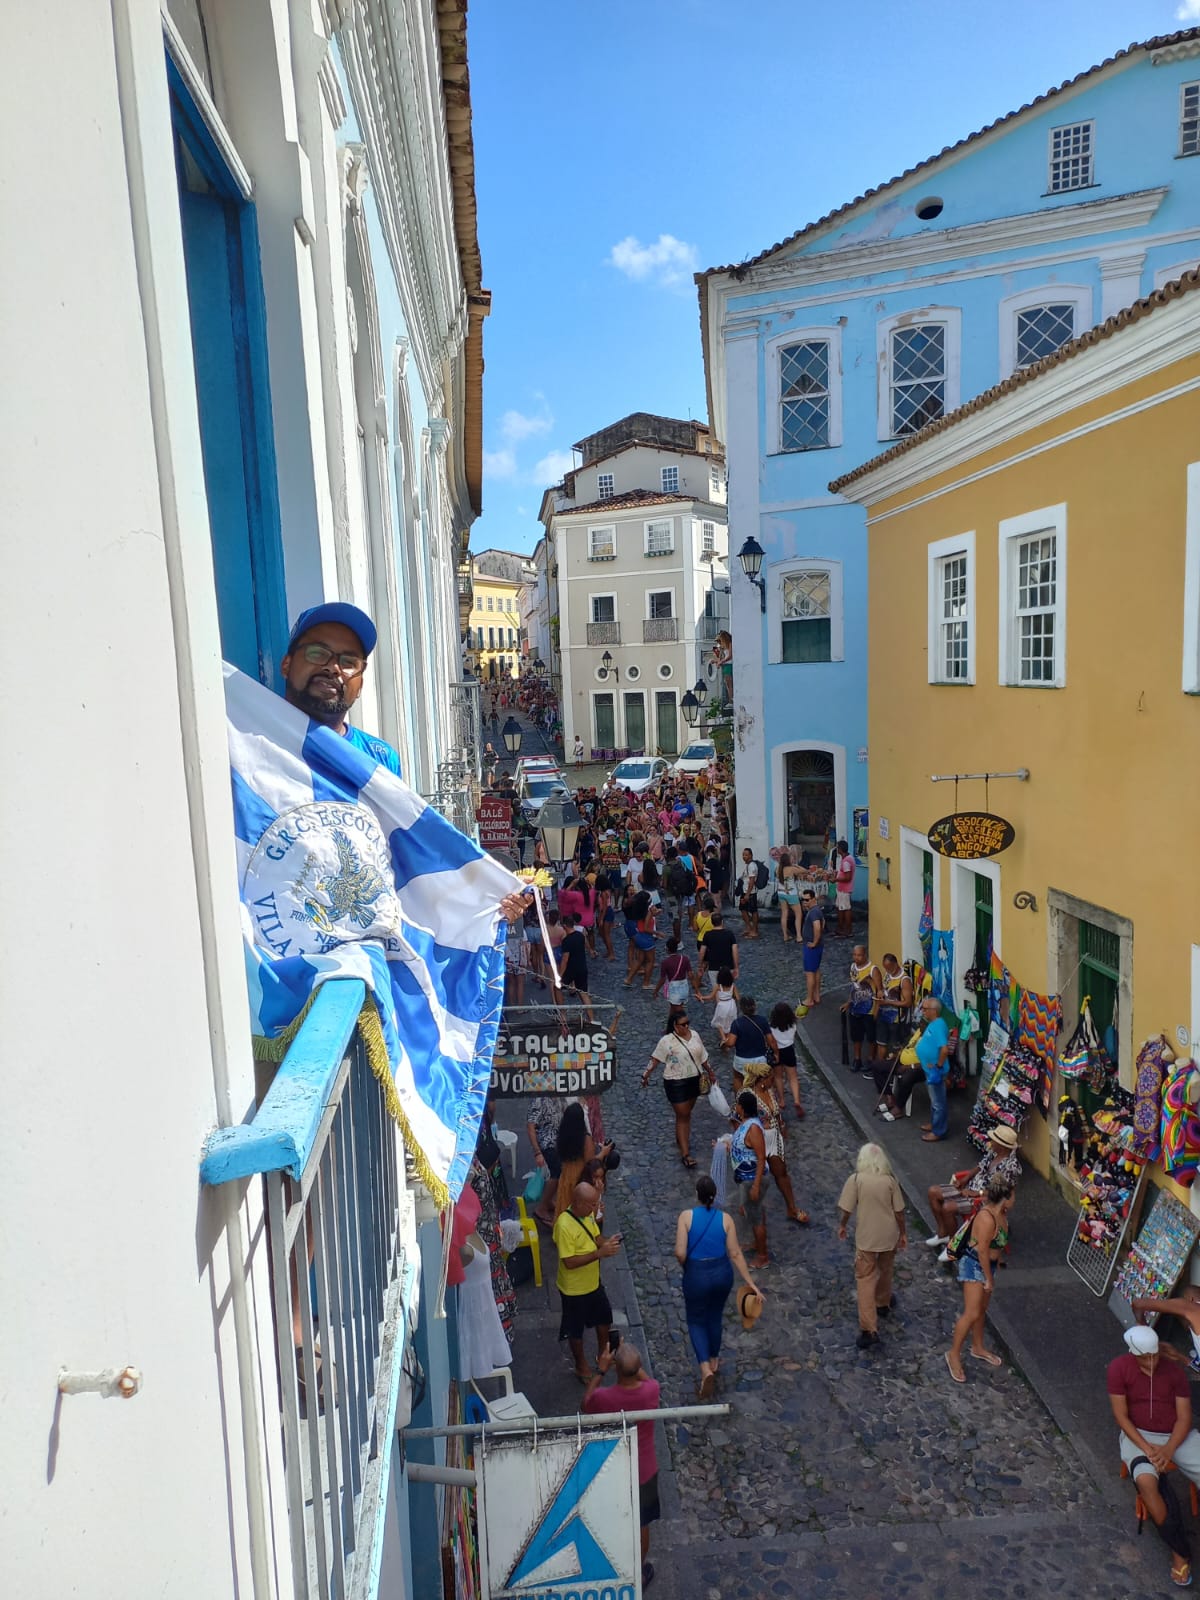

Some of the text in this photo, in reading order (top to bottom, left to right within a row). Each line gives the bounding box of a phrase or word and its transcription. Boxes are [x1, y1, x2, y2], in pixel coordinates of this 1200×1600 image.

[480, 807, 503, 818] BALÉ
[950, 850, 980, 858] ABCA
[956, 842, 990, 854] ANGOLA
[254, 891, 293, 957] VILA
[495, 1032, 608, 1056] ETALHOS
[529, 1056, 550, 1071] DA
[488, 1060, 612, 1093] OVÓ EDITH
